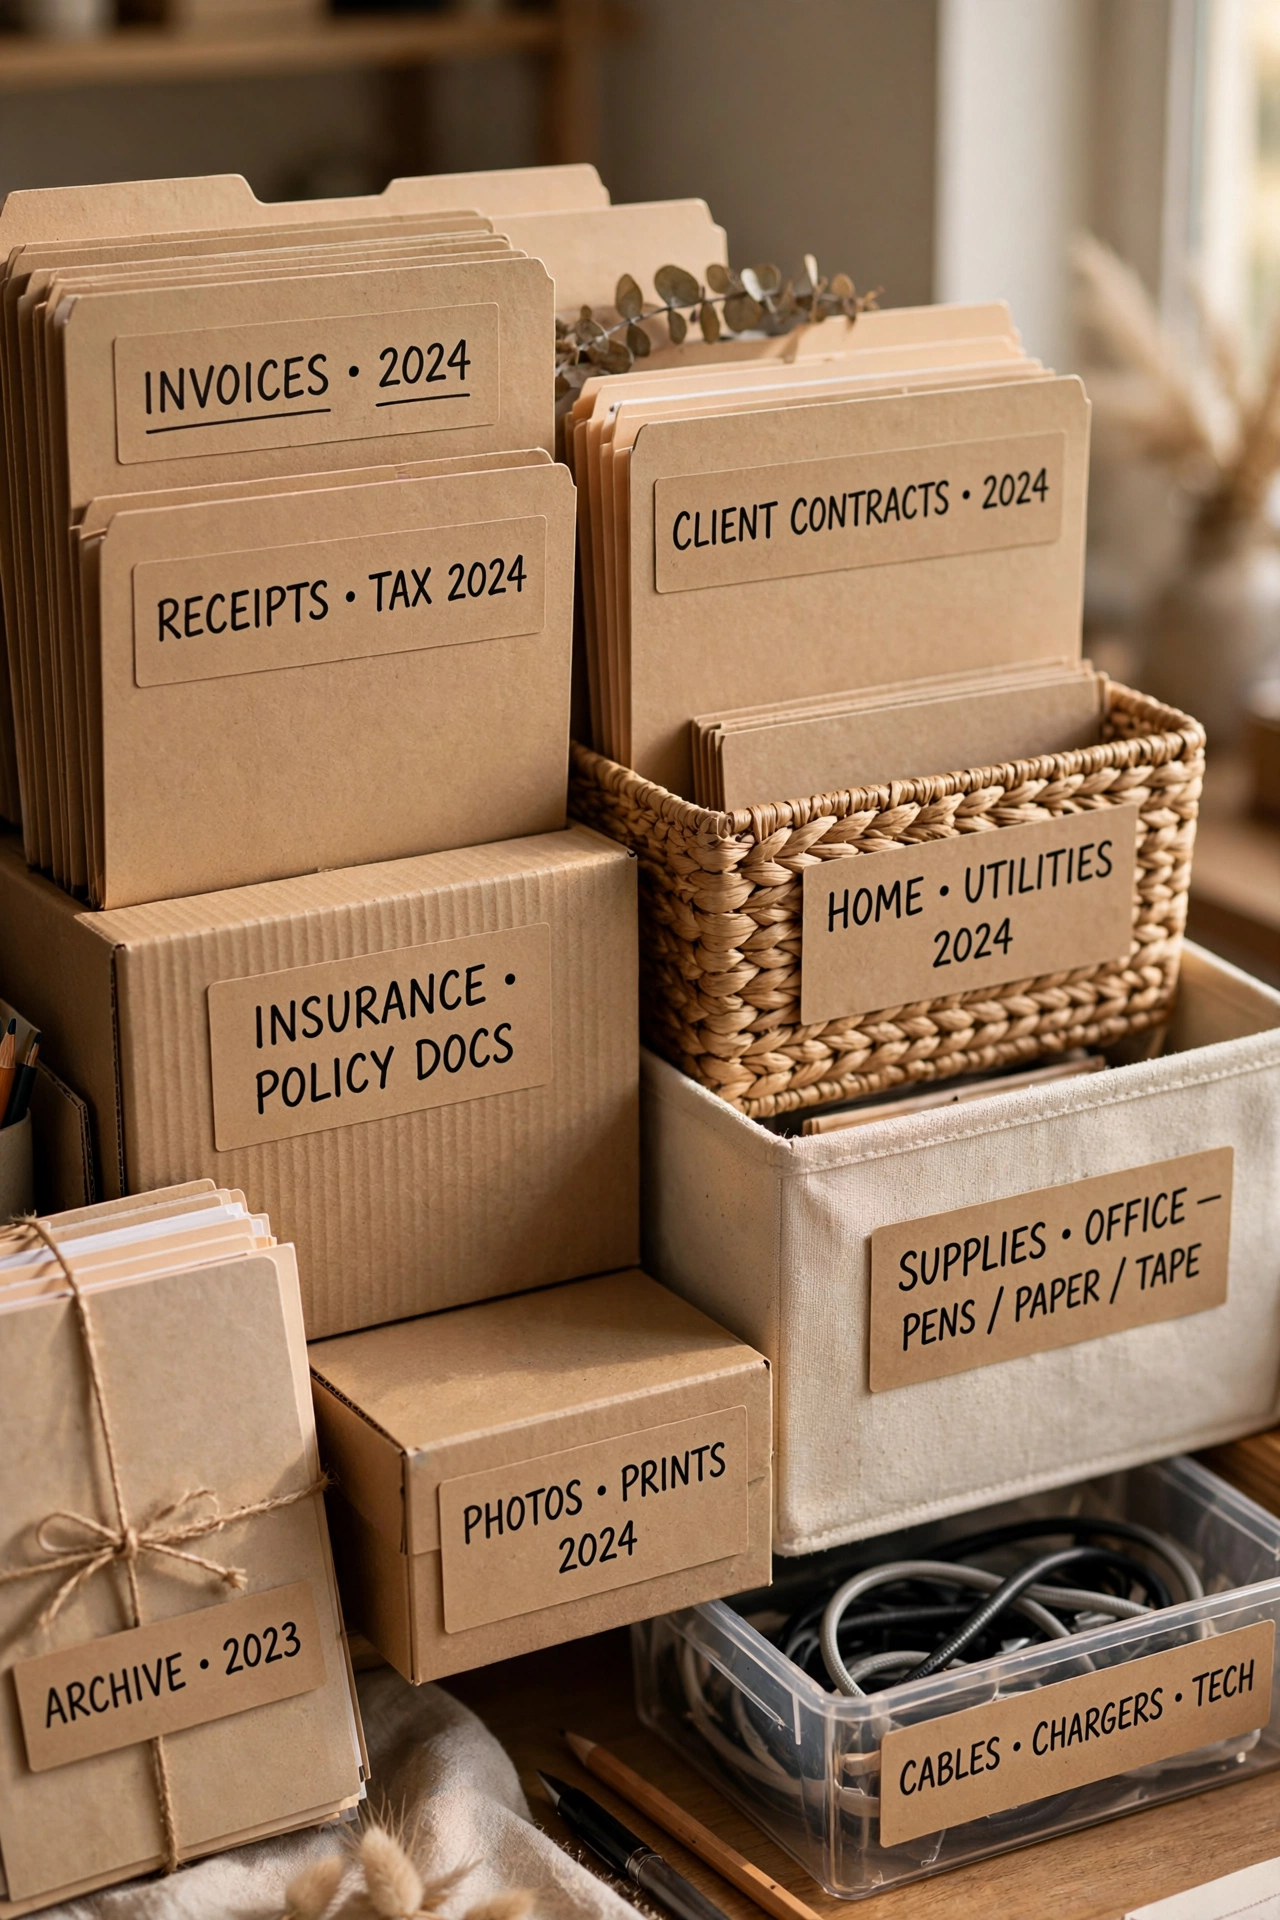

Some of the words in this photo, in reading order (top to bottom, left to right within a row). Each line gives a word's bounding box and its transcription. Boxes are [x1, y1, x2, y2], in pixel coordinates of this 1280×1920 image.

[145, 353, 329, 415] INVOICES
[378, 339, 471, 388] 2024
[672, 501, 779, 551] CLIENT
[790, 480, 949, 536] CONTRACTS
[982, 467, 1049, 510] 2024
[157, 579, 329, 643] RECEIPTS
[369, 567, 433, 613] TAX
[447, 554, 528, 602] 2024
[828, 875, 925, 933] HOME
[964, 839, 1113, 904] UTILITIES
[932, 917, 1014, 969] 2024
[255, 963, 487, 1049] INSURANCE
[255, 1045, 395, 1115] POLICY
[415, 1022, 514, 1081] DOCS
[898, 1221, 1047, 1292] SUPPLIES
[1085, 1186, 1188, 1246] OFFICE
[902, 1298, 976, 1352] PENS
[1015, 1268, 1100, 1323] PAPER
[1135, 1242, 1202, 1291] TAPE
[463, 1479, 583, 1545] PHOTOS
[621, 1441, 726, 1503] PRINTS
[558, 1519, 638, 1574] 2024
[45, 1651, 187, 1729] ARCHIVE
[222, 1621, 302, 1676] 2023
[899, 1736, 1001, 1796] CABLES
[1032, 1687, 1164, 1756] CHARGERS
[1191, 1658, 1255, 1707] TECH
